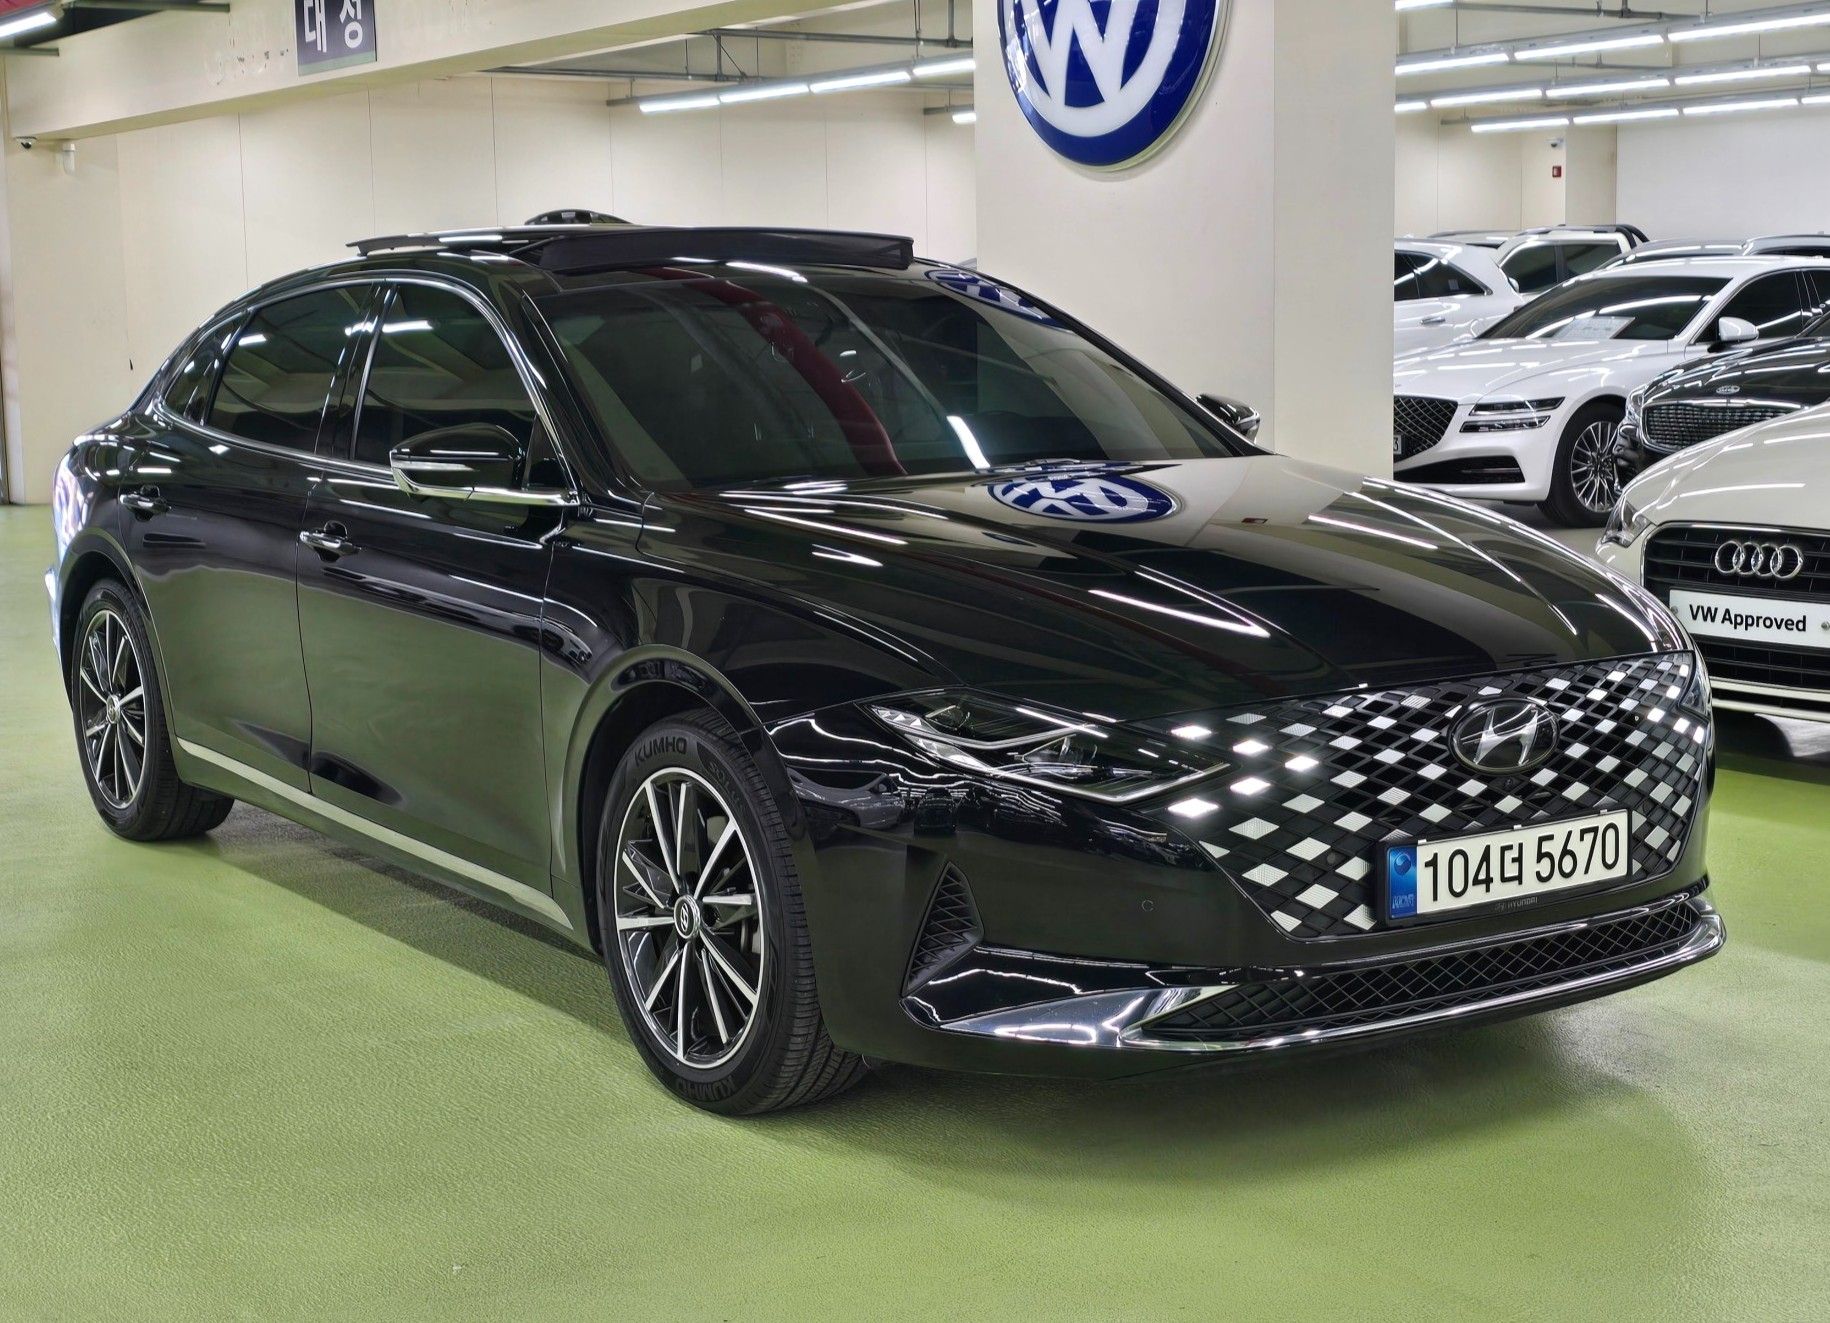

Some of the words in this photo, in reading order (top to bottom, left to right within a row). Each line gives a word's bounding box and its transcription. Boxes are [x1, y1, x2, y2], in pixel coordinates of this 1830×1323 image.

[1689, 603, 1719, 623] VW
[1721, 608, 1807, 632] Approved
[635, 736, 688, 766] KUMHO
[1424, 842, 1524, 902] 104더
[1535, 822, 1620, 883] 5670
